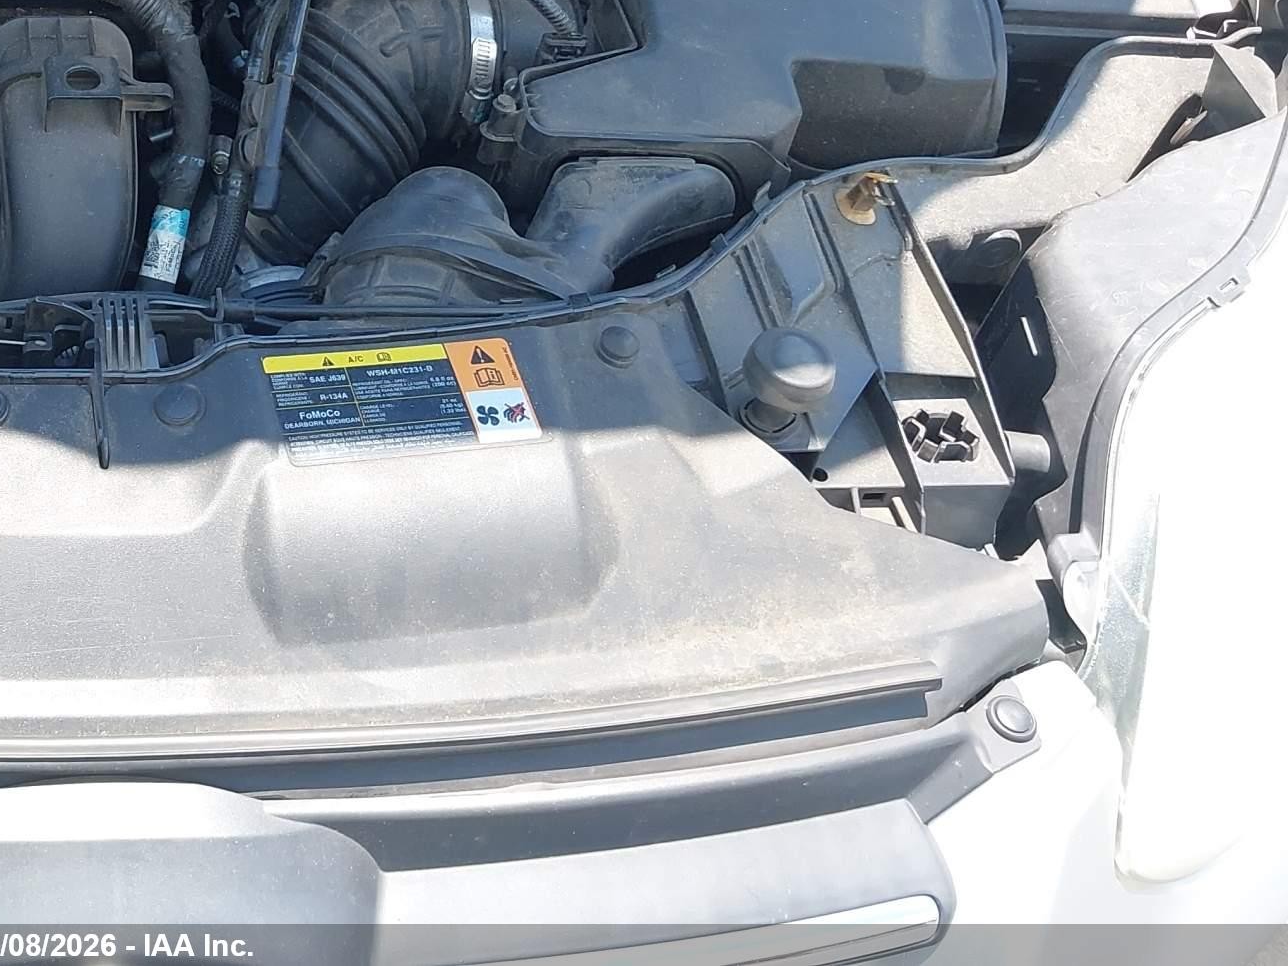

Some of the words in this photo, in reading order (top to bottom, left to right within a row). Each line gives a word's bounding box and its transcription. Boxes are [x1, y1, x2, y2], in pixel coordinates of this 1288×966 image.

[348, 355, 364, 364] A/C
[309, 375, 326, 384] SAE
[328, 374, 346, 382] J639
[320, 392, 349, 401] R-134A
[299, 409, 341, 420] FoMoCo
[326, 417, 361, 426] MICHIGAN
